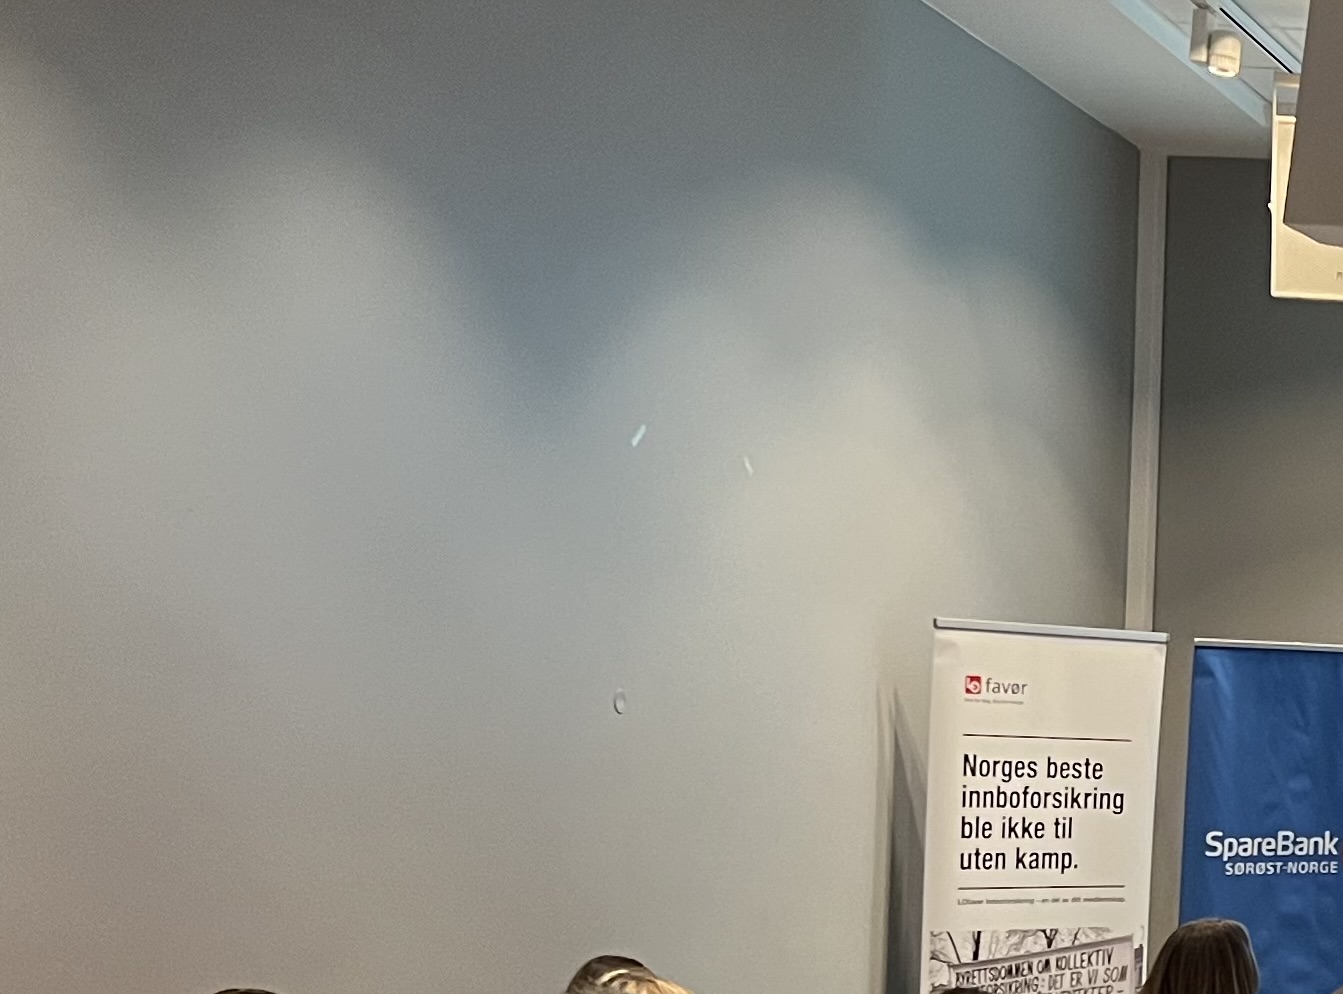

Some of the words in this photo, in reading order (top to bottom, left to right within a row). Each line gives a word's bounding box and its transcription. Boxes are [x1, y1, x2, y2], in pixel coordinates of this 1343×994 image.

[985, 677, 1028, 695] favør
[963, 754, 1038, 783] Norges
[1047, 756, 1104, 780] beste
[961, 785, 1125, 815] innboforsikring
[961, 816, 993, 839] ble
[1001, 816, 1045, 839] ikke
[1054, 817, 1073, 839] til
[1205, 830, 1339, 862] SpareBank
[960, 848, 1006, 870] uten
[1015, 846, 1078, 875] kamp.
[1225, 861, 1339, 876] SØRØST-NORGE
[1056, 947, 1114, 971] KOLLEKTIV
[1070, 971, 1083, 988] ER
[1087, 969, 1099, 985] VI
[1103, 965, 1128, 984] SOM
